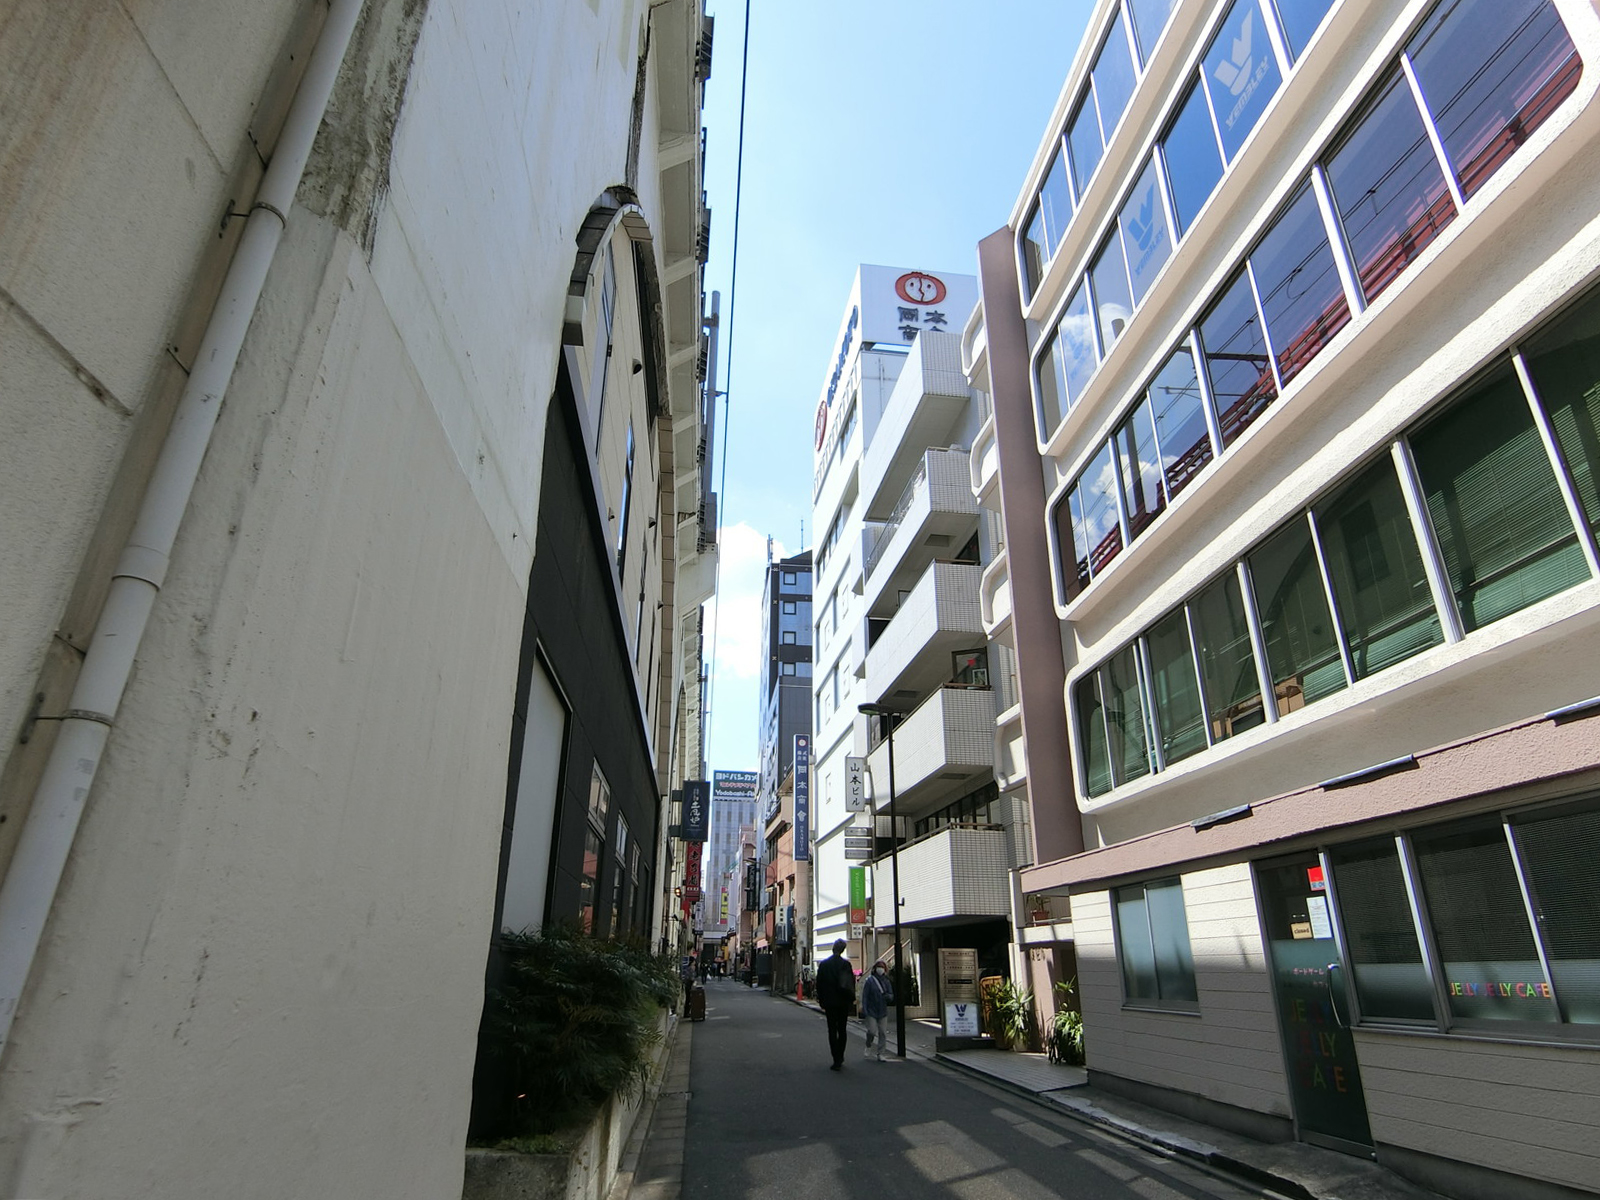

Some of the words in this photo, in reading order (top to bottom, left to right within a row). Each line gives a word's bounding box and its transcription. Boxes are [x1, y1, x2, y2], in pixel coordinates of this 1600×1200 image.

[898, 324, 946, 341] 商
[850, 763, 861, 807] 山本ビル
[1451, 982, 1479, 996] JELLY
[1483, 982, 1512, 997] JELLY
[1515, 982, 1551, 998] CAFE
